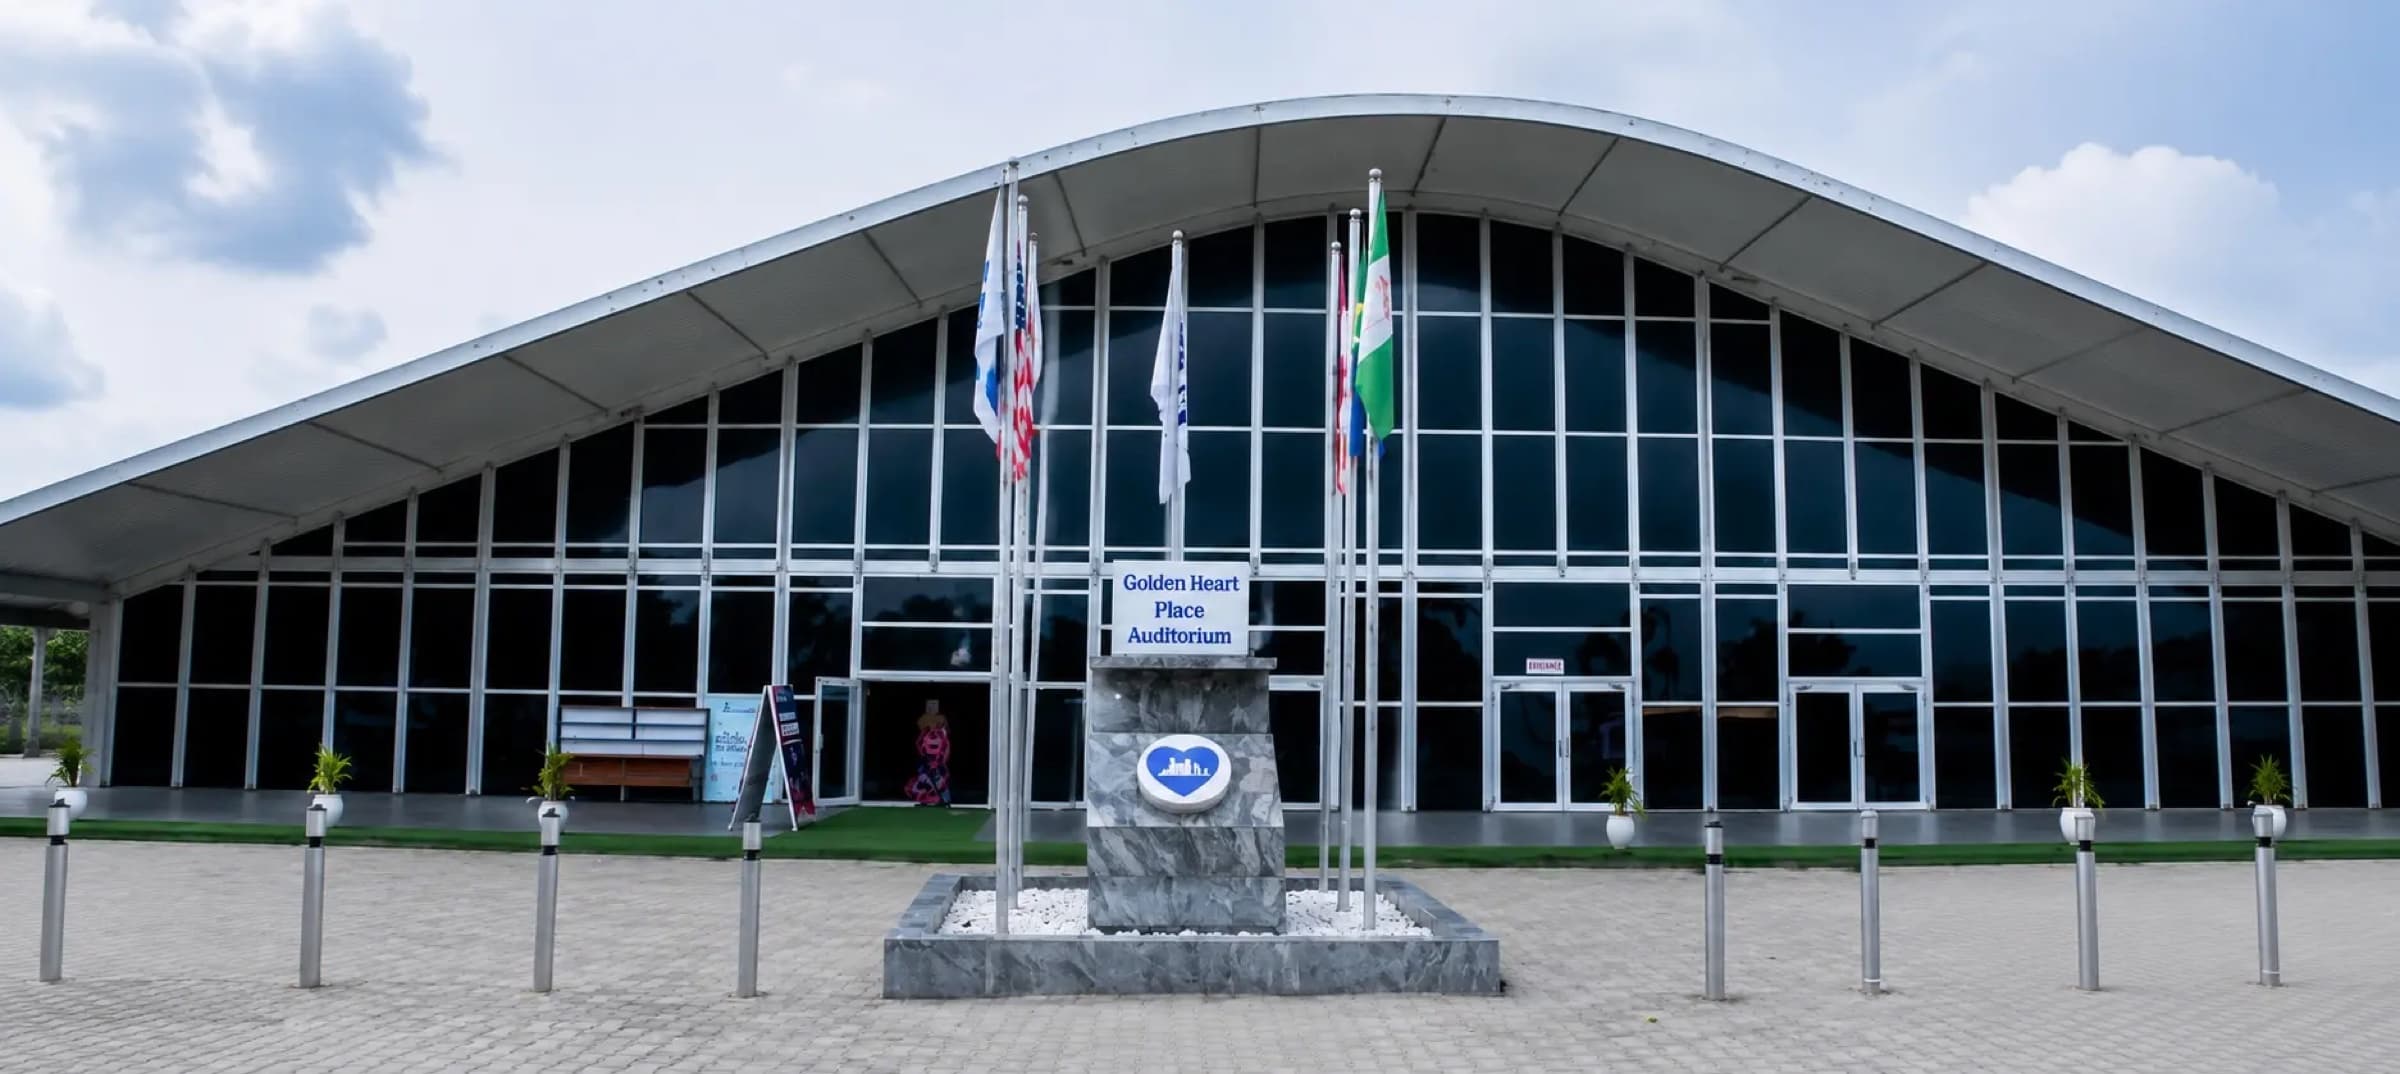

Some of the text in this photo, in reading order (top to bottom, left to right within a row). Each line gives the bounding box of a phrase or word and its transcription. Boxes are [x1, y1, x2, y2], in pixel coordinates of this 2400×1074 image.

[1123, 574, 1240, 591] Golden Heart
[1155, 601, 1205, 618] Place
[1128, 627, 1232, 644] Auditorium
